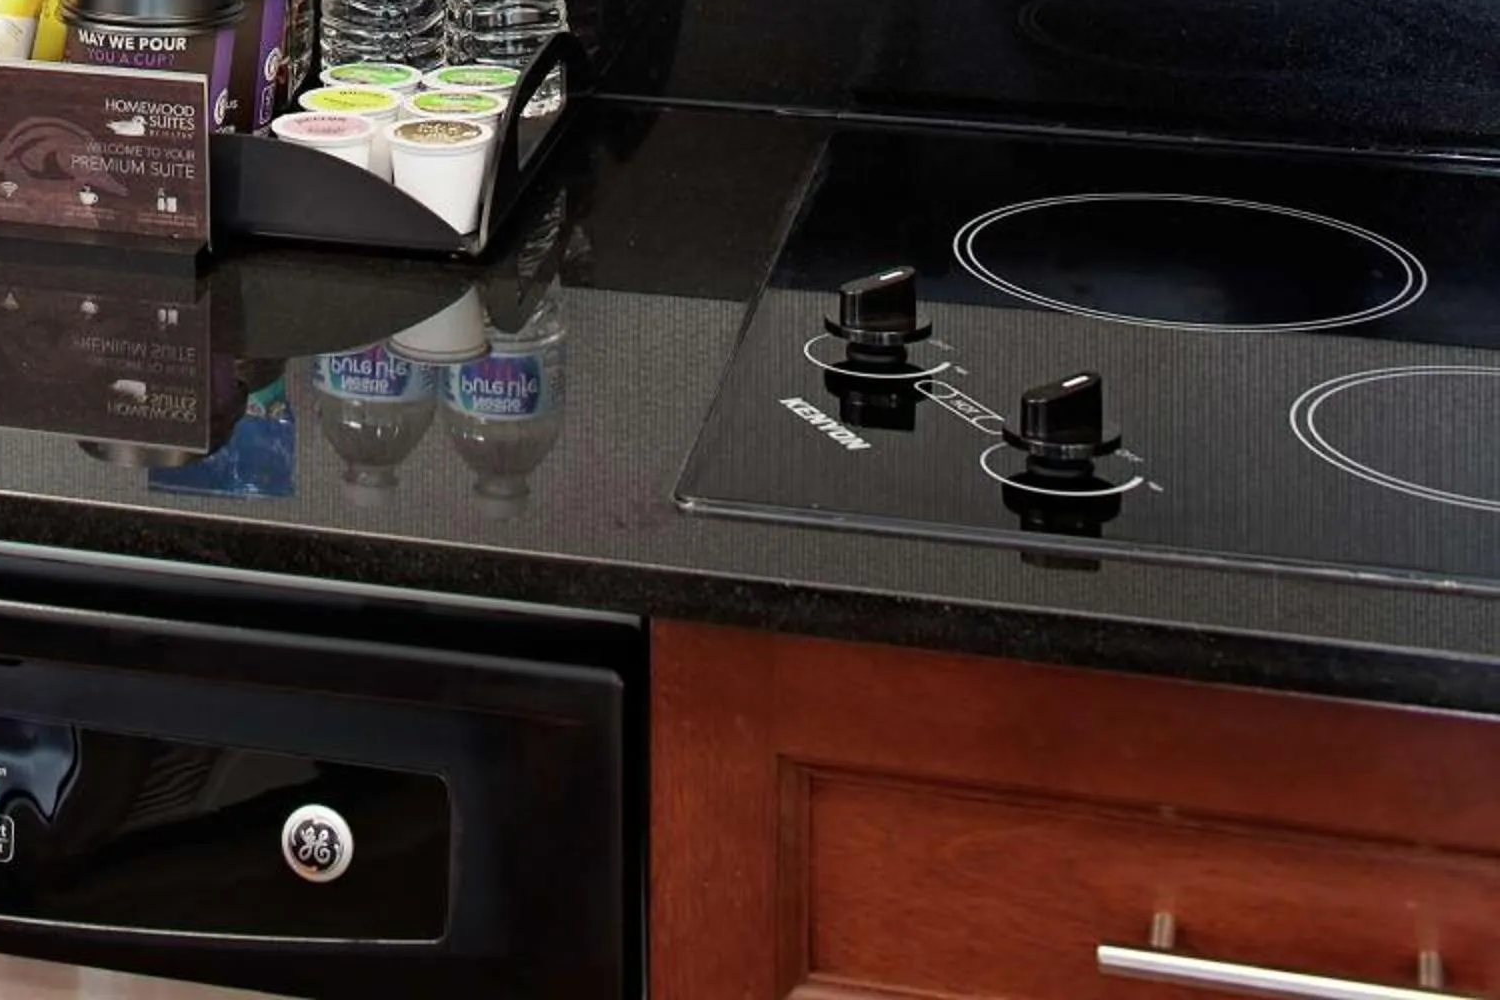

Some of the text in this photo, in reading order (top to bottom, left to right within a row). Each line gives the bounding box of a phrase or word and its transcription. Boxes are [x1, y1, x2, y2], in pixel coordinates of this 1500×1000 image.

[78, 29, 187, 51] MAY WE POUR
[88, 48, 175, 67] YOU A CUP?
[105, 98, 195, 117] HOMEWOOD
[149, 115, 195, 130] SUITES
[147, 146, 161, 157] TO
[71, 154, 196, 179] PREMIUM SUITE
[779, 397, 872, 450] KENYON
